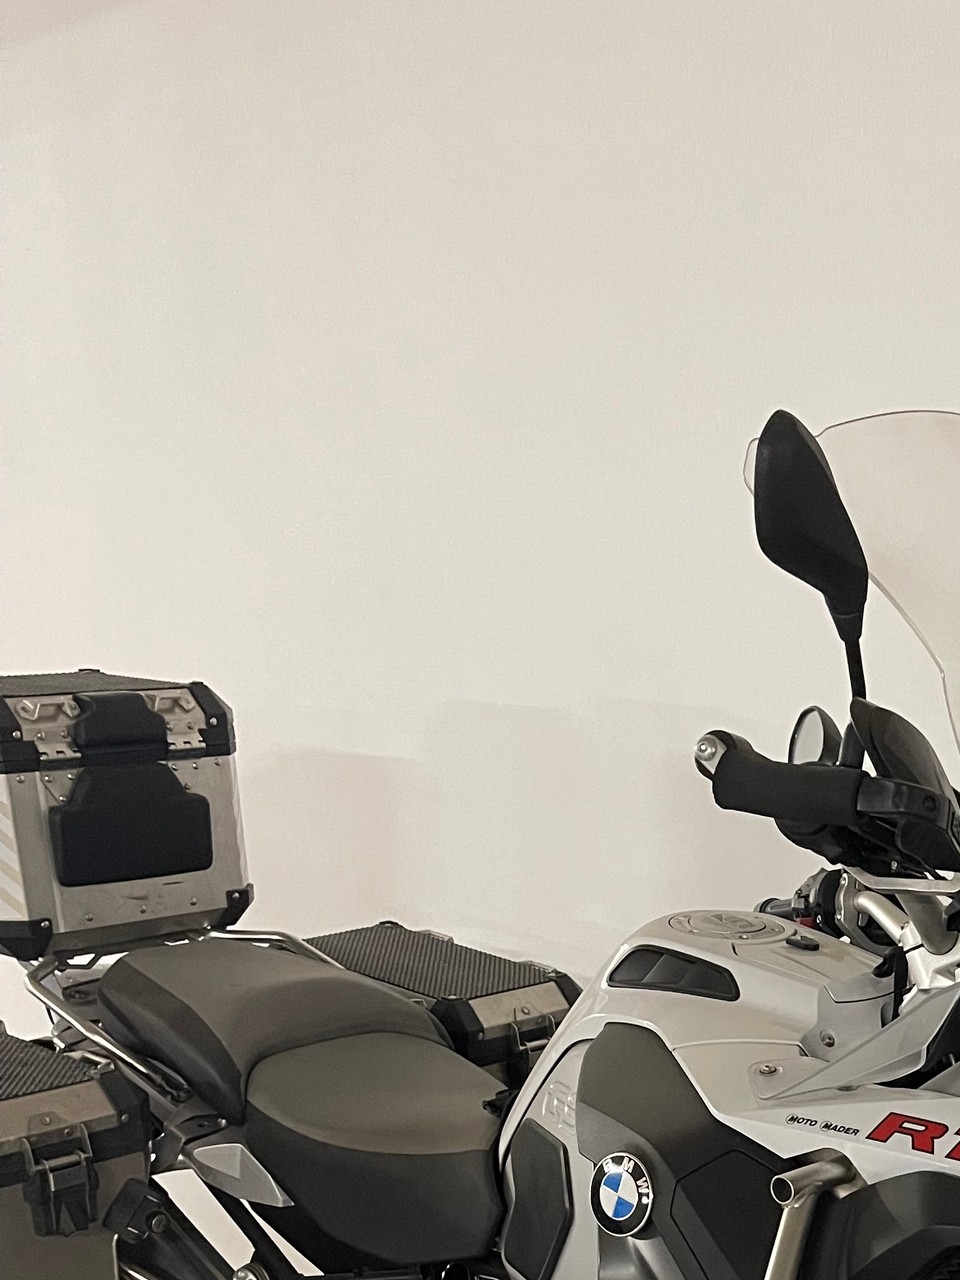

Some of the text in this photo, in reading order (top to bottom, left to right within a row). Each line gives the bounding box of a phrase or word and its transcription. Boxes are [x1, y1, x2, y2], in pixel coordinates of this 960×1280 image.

[786, 1114, 860, 1136] MOTO MADER
[602, 1156, 650, 1194] BMW
